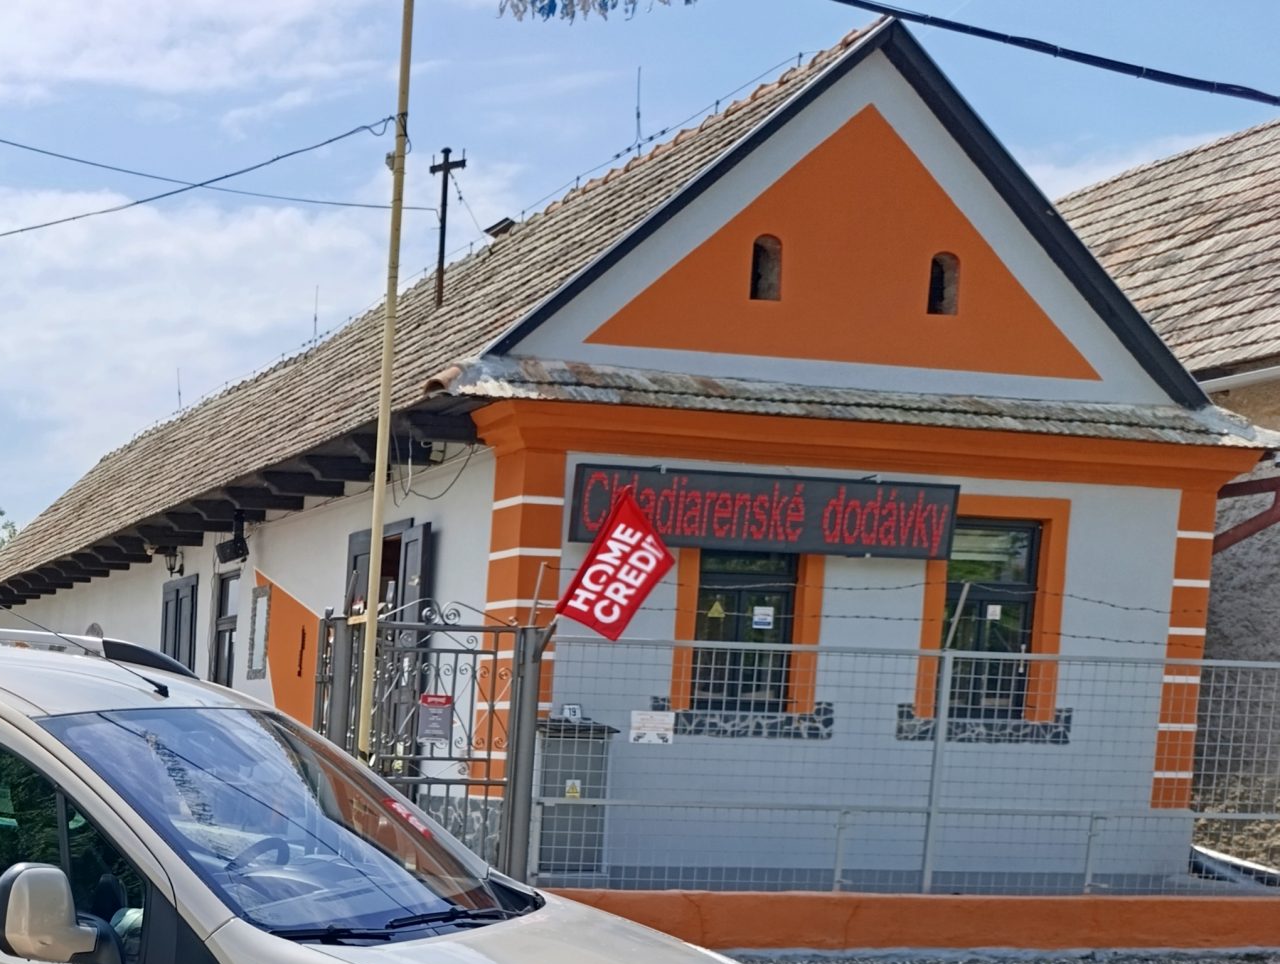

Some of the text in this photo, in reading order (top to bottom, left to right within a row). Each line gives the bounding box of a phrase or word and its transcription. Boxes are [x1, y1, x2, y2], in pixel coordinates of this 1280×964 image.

[822, 485, 949, 557] dodávky
[567, 523, 643, 612] HOME
[568, 707, 577, 717] 19
